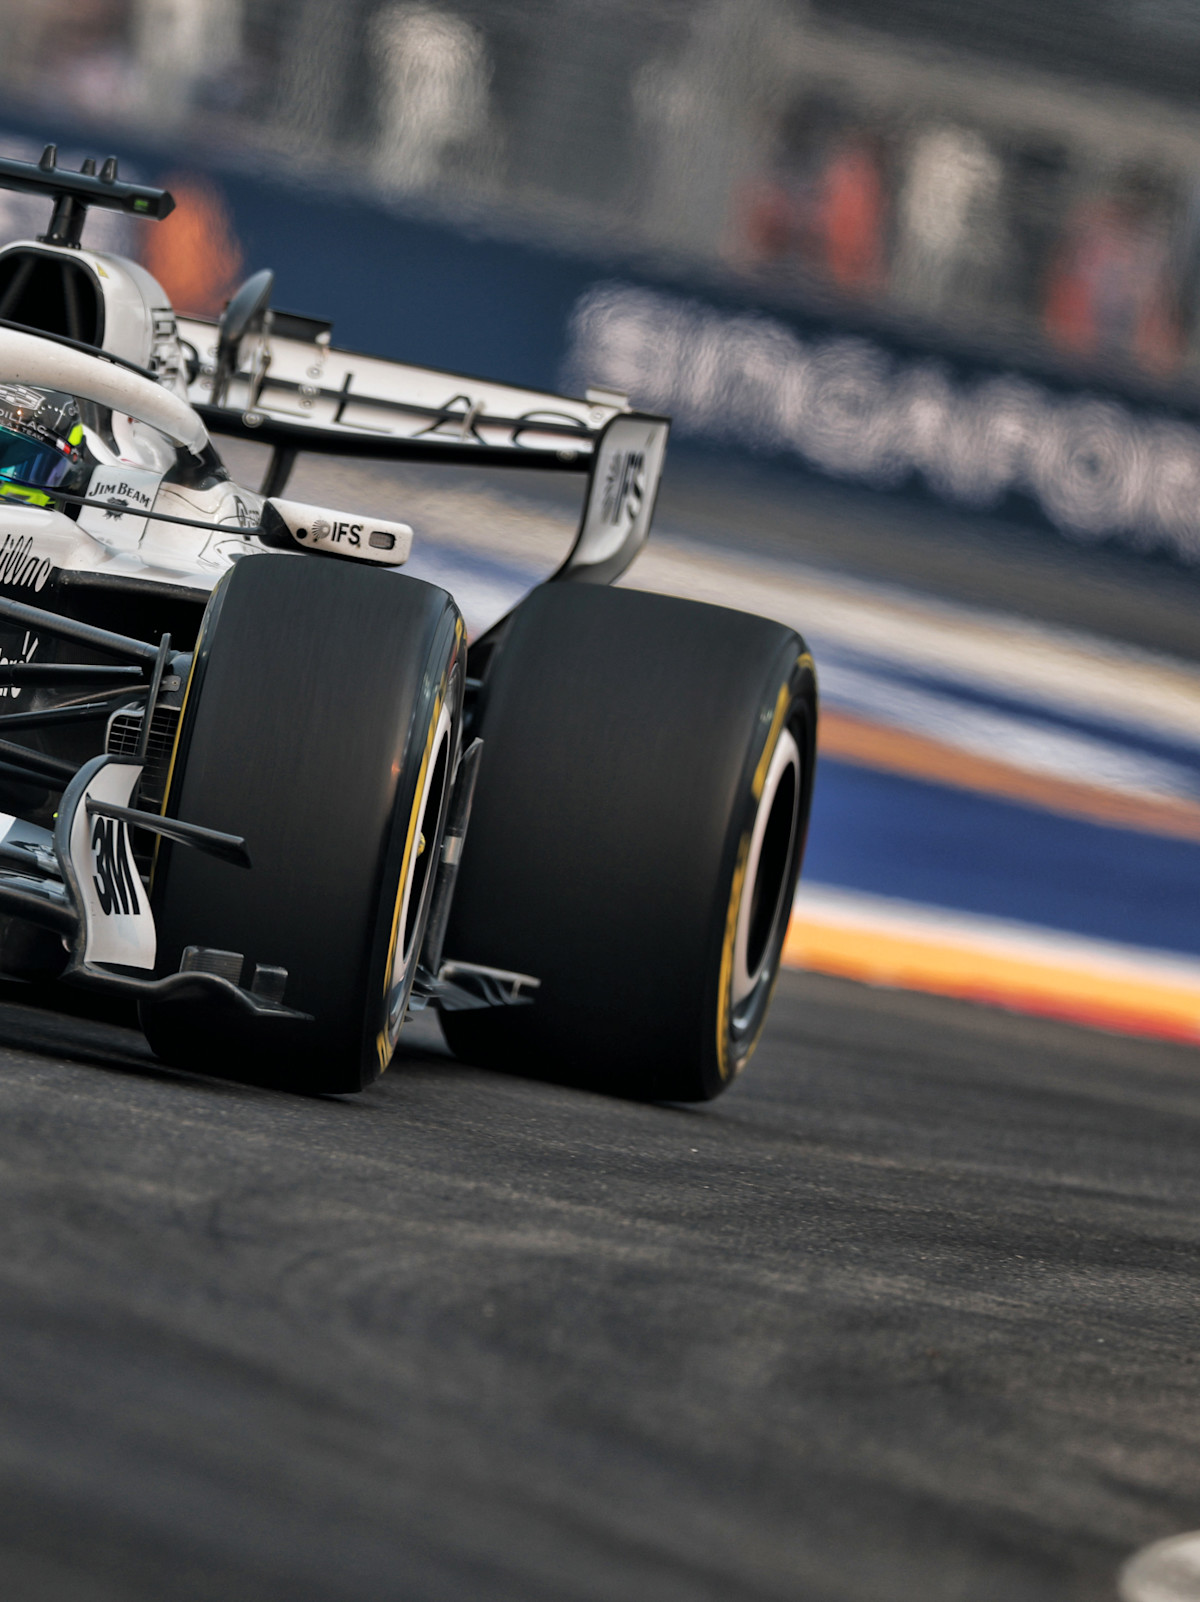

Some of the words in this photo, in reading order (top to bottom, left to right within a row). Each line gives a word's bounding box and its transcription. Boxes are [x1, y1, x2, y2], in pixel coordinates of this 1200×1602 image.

[21, 427, 44, 441] TEAM
[88, 482, 116, 497] JIM
[117, 482, 151, 508] BEAM
[331, 521, 361, 546] IFS
[92, 816, 141, 916] 3M
